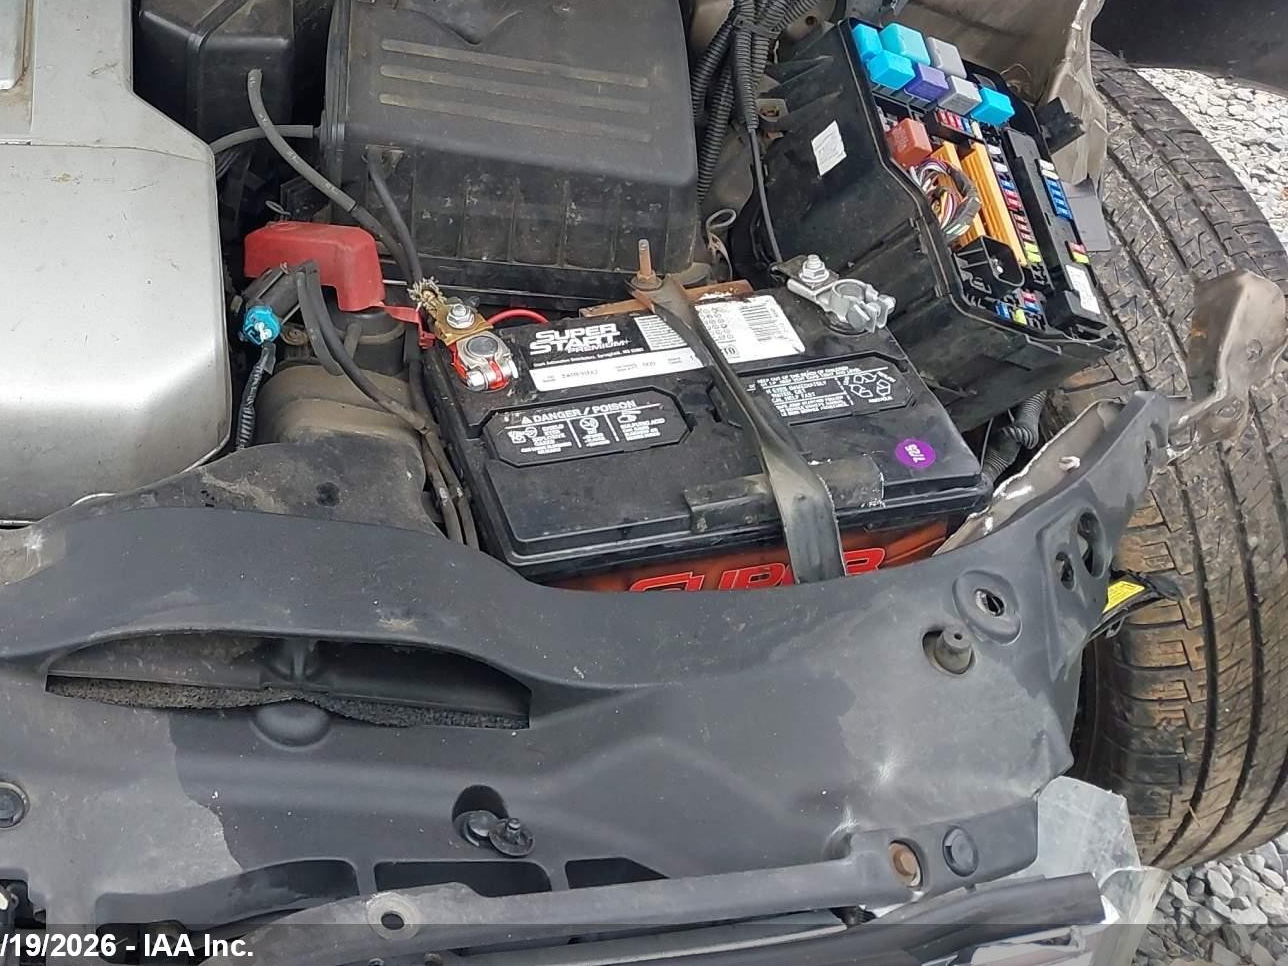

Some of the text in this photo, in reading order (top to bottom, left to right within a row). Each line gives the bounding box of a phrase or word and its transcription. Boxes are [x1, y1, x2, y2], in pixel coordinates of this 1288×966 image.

[535, 323, 621, 341] SUPER
[529, 333, 616, 355] START
[532, 409, 581, 423] DANGER
[591, 400, 637, 414] POISON
